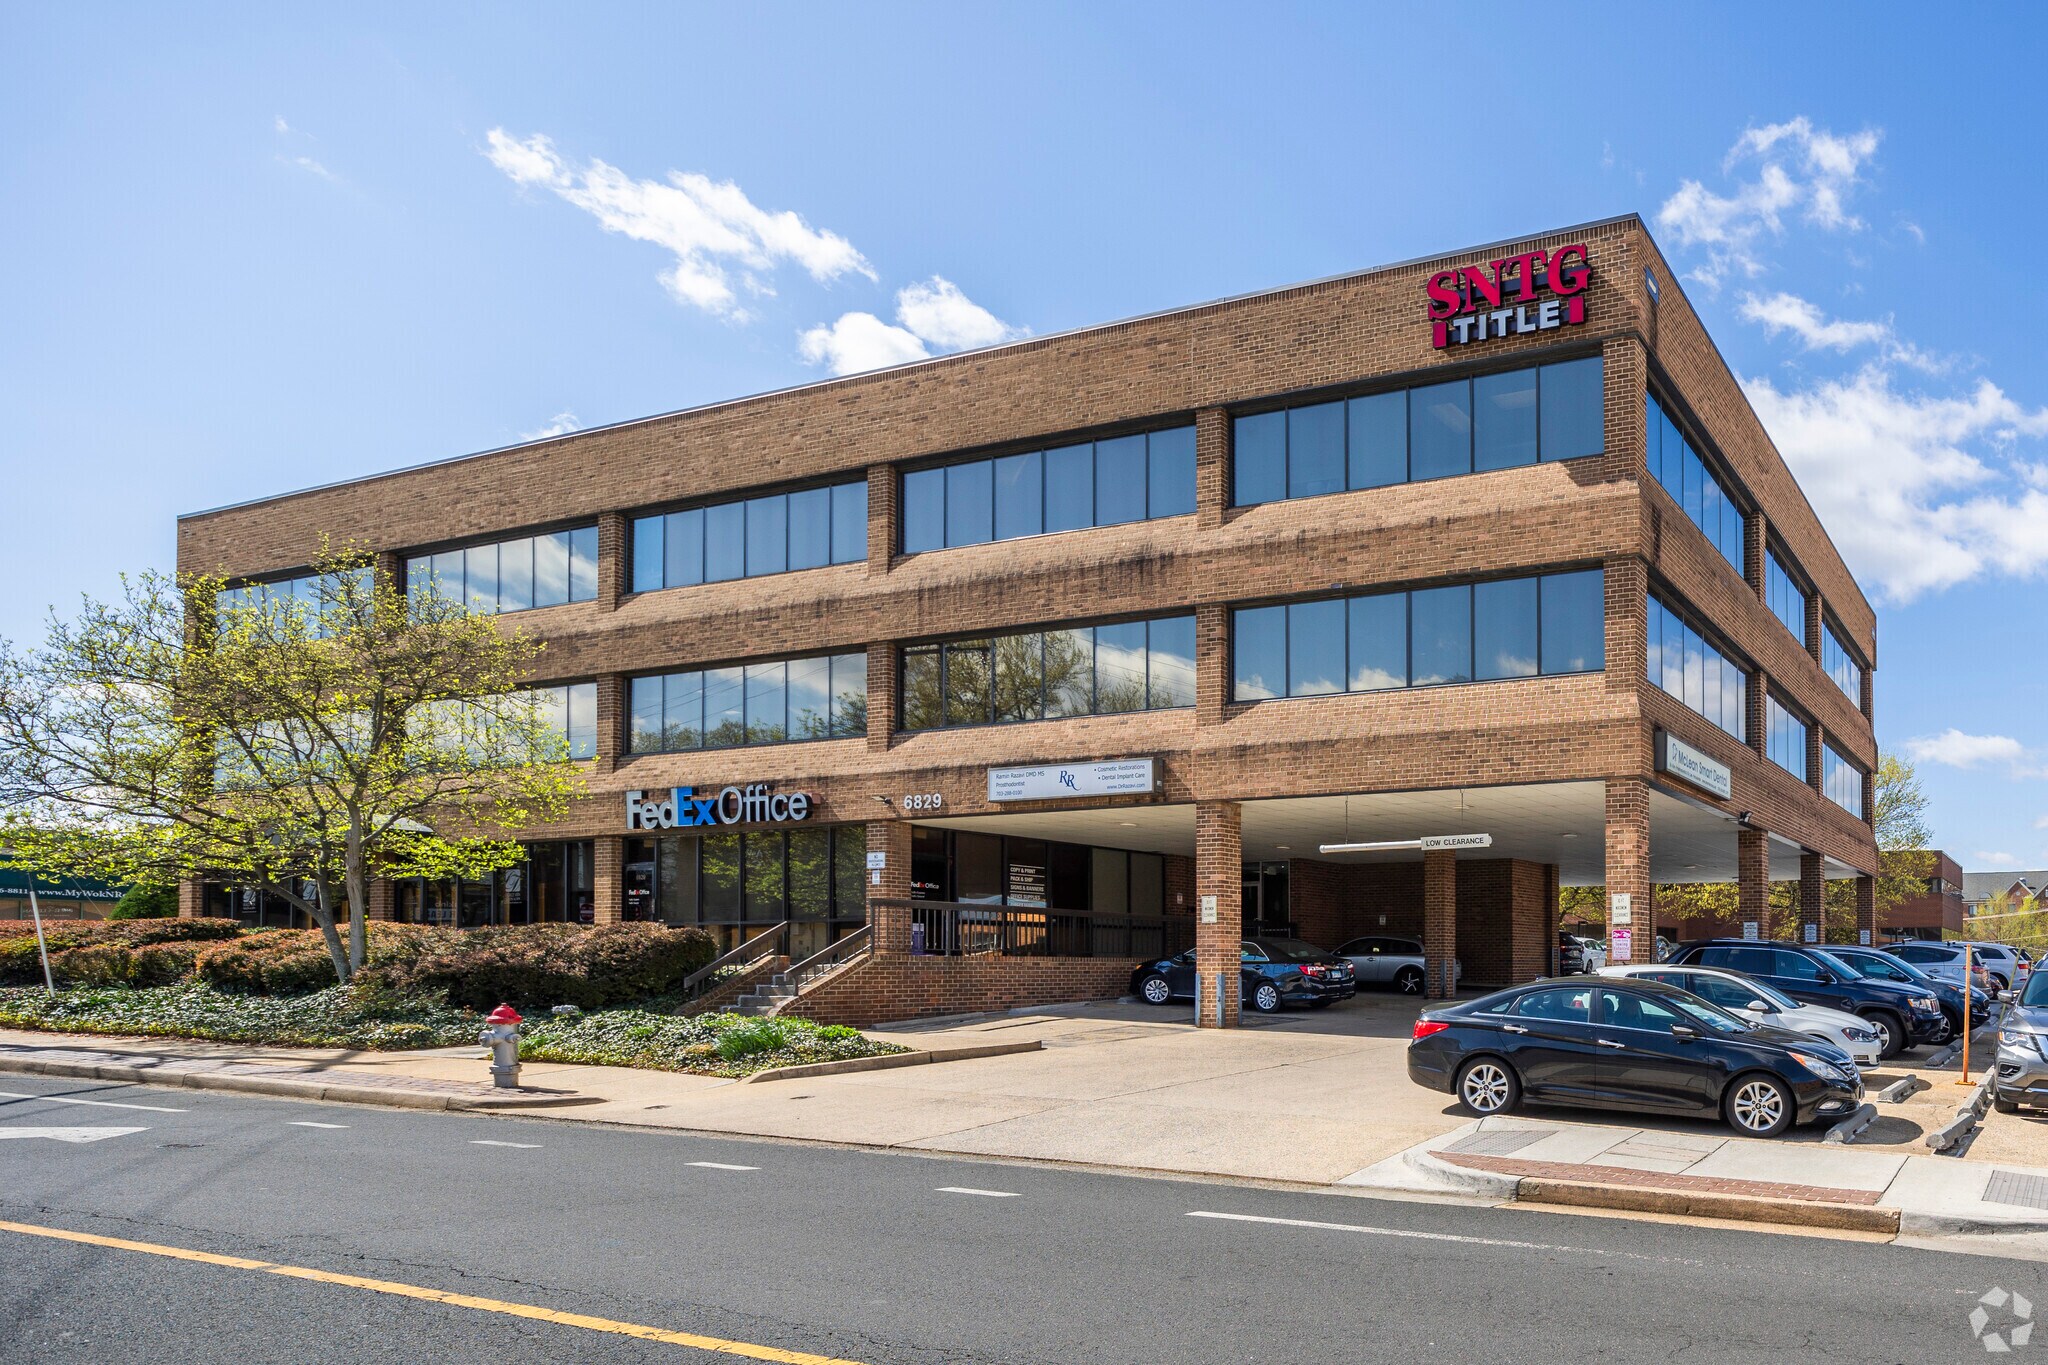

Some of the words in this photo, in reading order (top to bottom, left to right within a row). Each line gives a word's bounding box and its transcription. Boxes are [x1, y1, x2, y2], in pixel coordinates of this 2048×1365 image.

[1426, 243, 1591, 320] SNTG
[1453, 299, 1560, 344] TITLE
[1117, 773, 1134, 781] Implant
[1678, 750, 1699, 772] McLean
[1699, 761, 1713, 781] Smart
[1713, 767, 1728, 787] Dental
[626, 786, 717, 830] FedEx
[717, 783, 808, 825] Office
[903, 793, 942, 810] 6829
[1425, 839, 1441, 847] LOW
[1443, 837, 1484, 846] CLEARANCE
